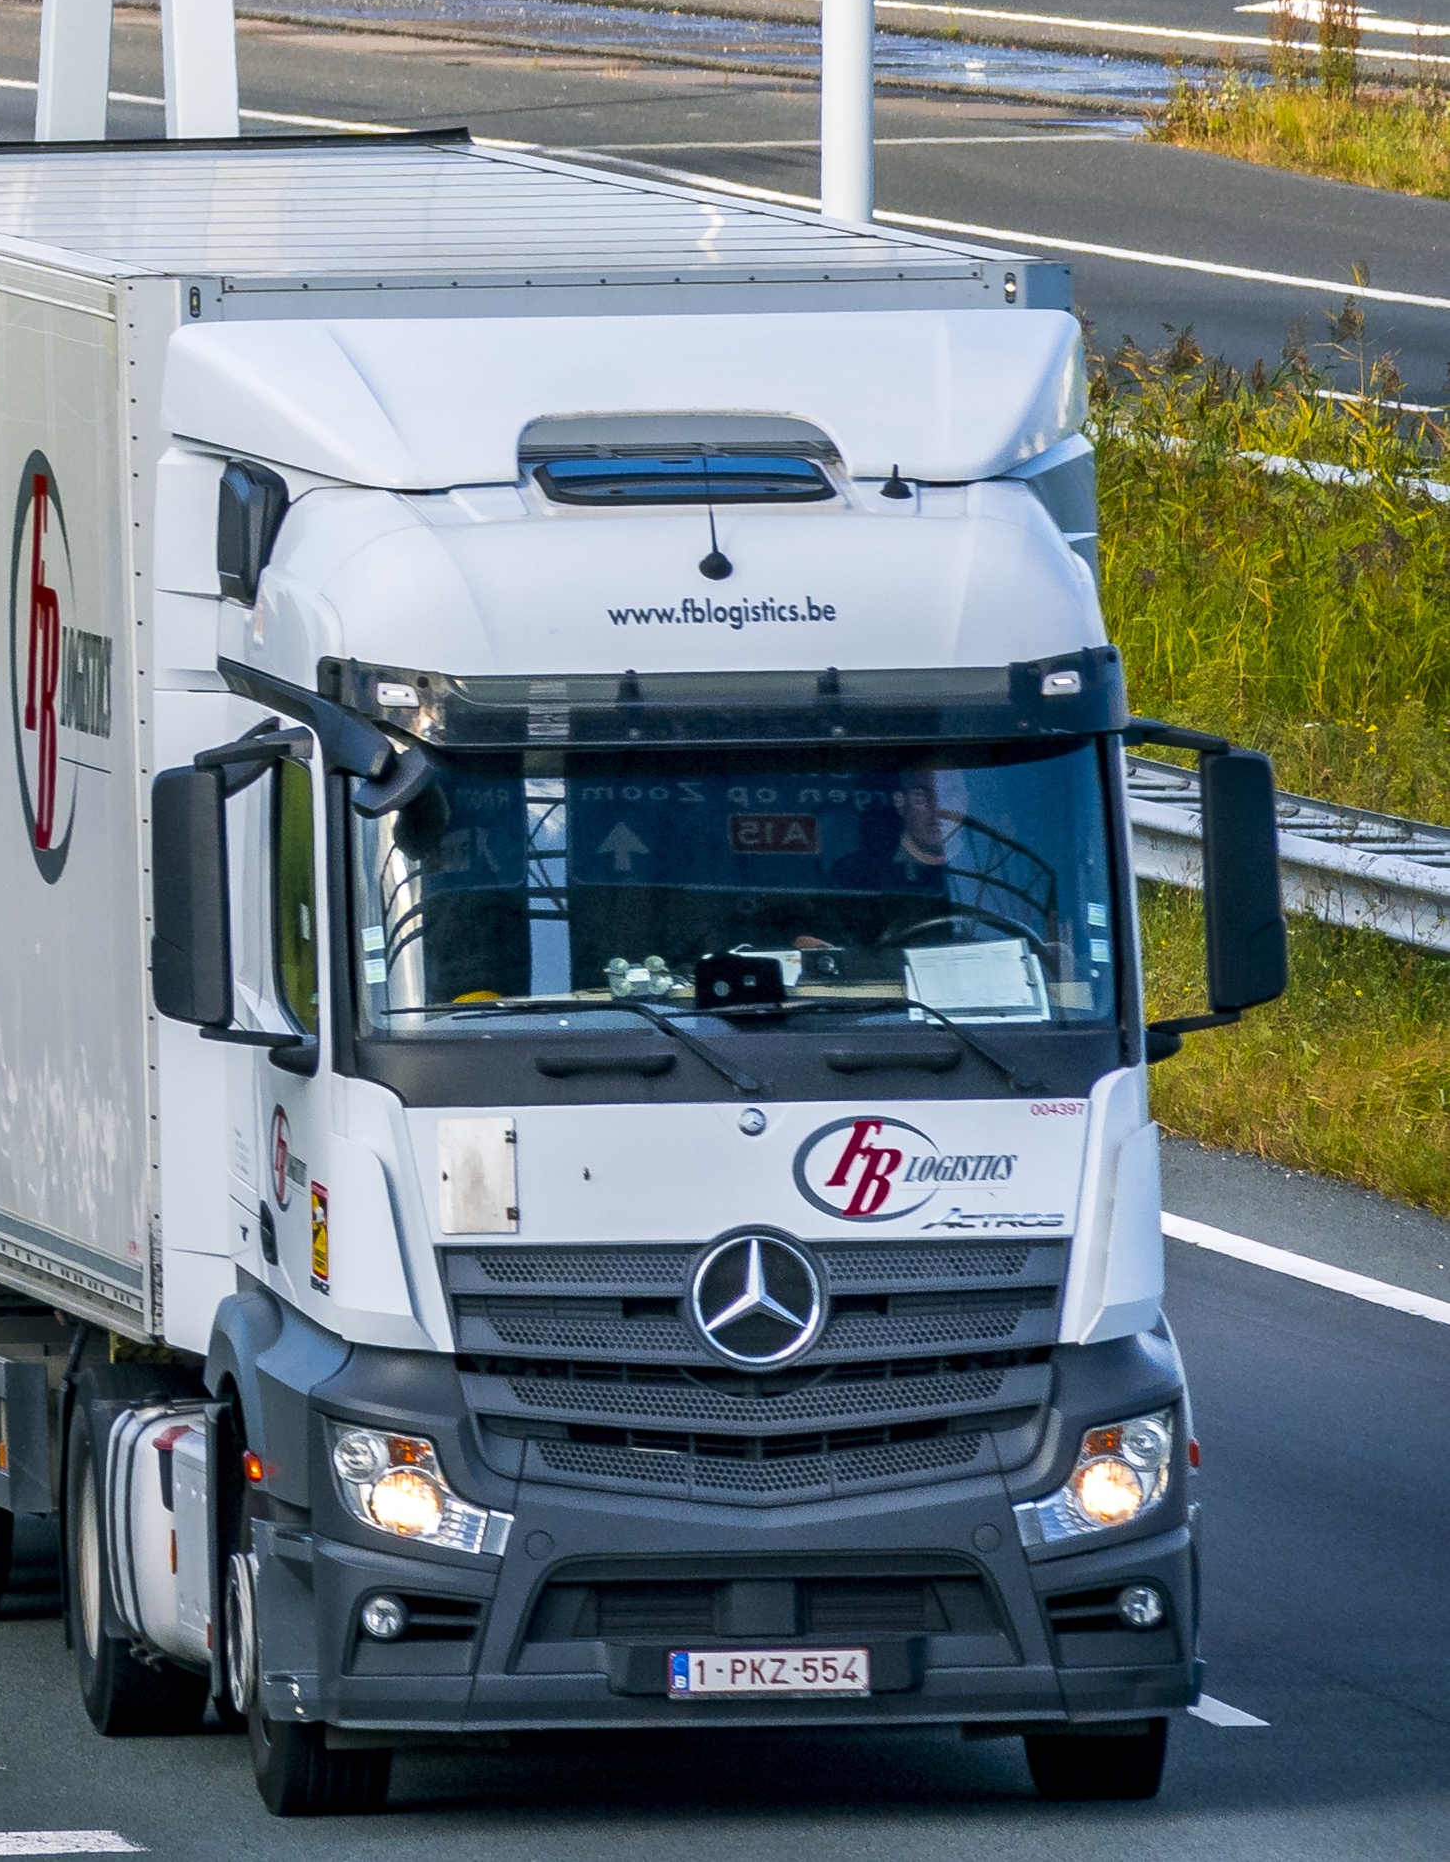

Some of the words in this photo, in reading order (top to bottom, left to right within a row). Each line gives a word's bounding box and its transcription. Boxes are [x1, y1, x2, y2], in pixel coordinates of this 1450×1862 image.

[607, 595, 837, 630] www.fblogistics.be
[1030, 1102, 1086, 1116] 004397
[901, 1154, 1019, 1183] LOGISTICS
[695, 1656, 859, 1686] 1-PKZ-554
